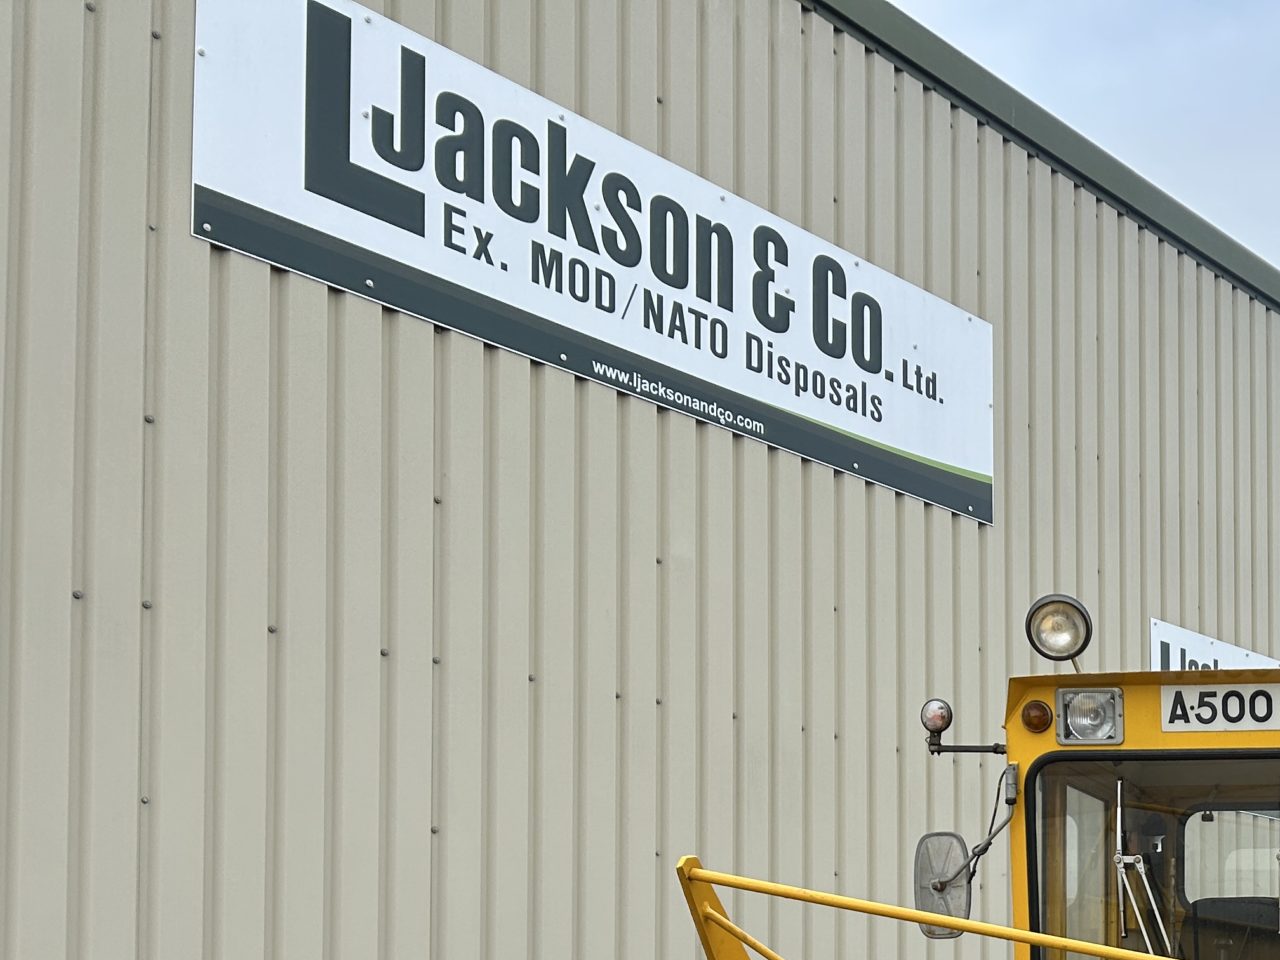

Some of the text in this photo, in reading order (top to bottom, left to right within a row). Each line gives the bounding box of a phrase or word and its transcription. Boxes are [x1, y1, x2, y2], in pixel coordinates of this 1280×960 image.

[444, 203, 508, 271] Ex.
[745, 331, 883, 423] Disposals
[592, 359, 764, 434] www.ljacksonandco.com
[752, 225, 795, 333] &
[902, 358, 944, 404] Ltd.
